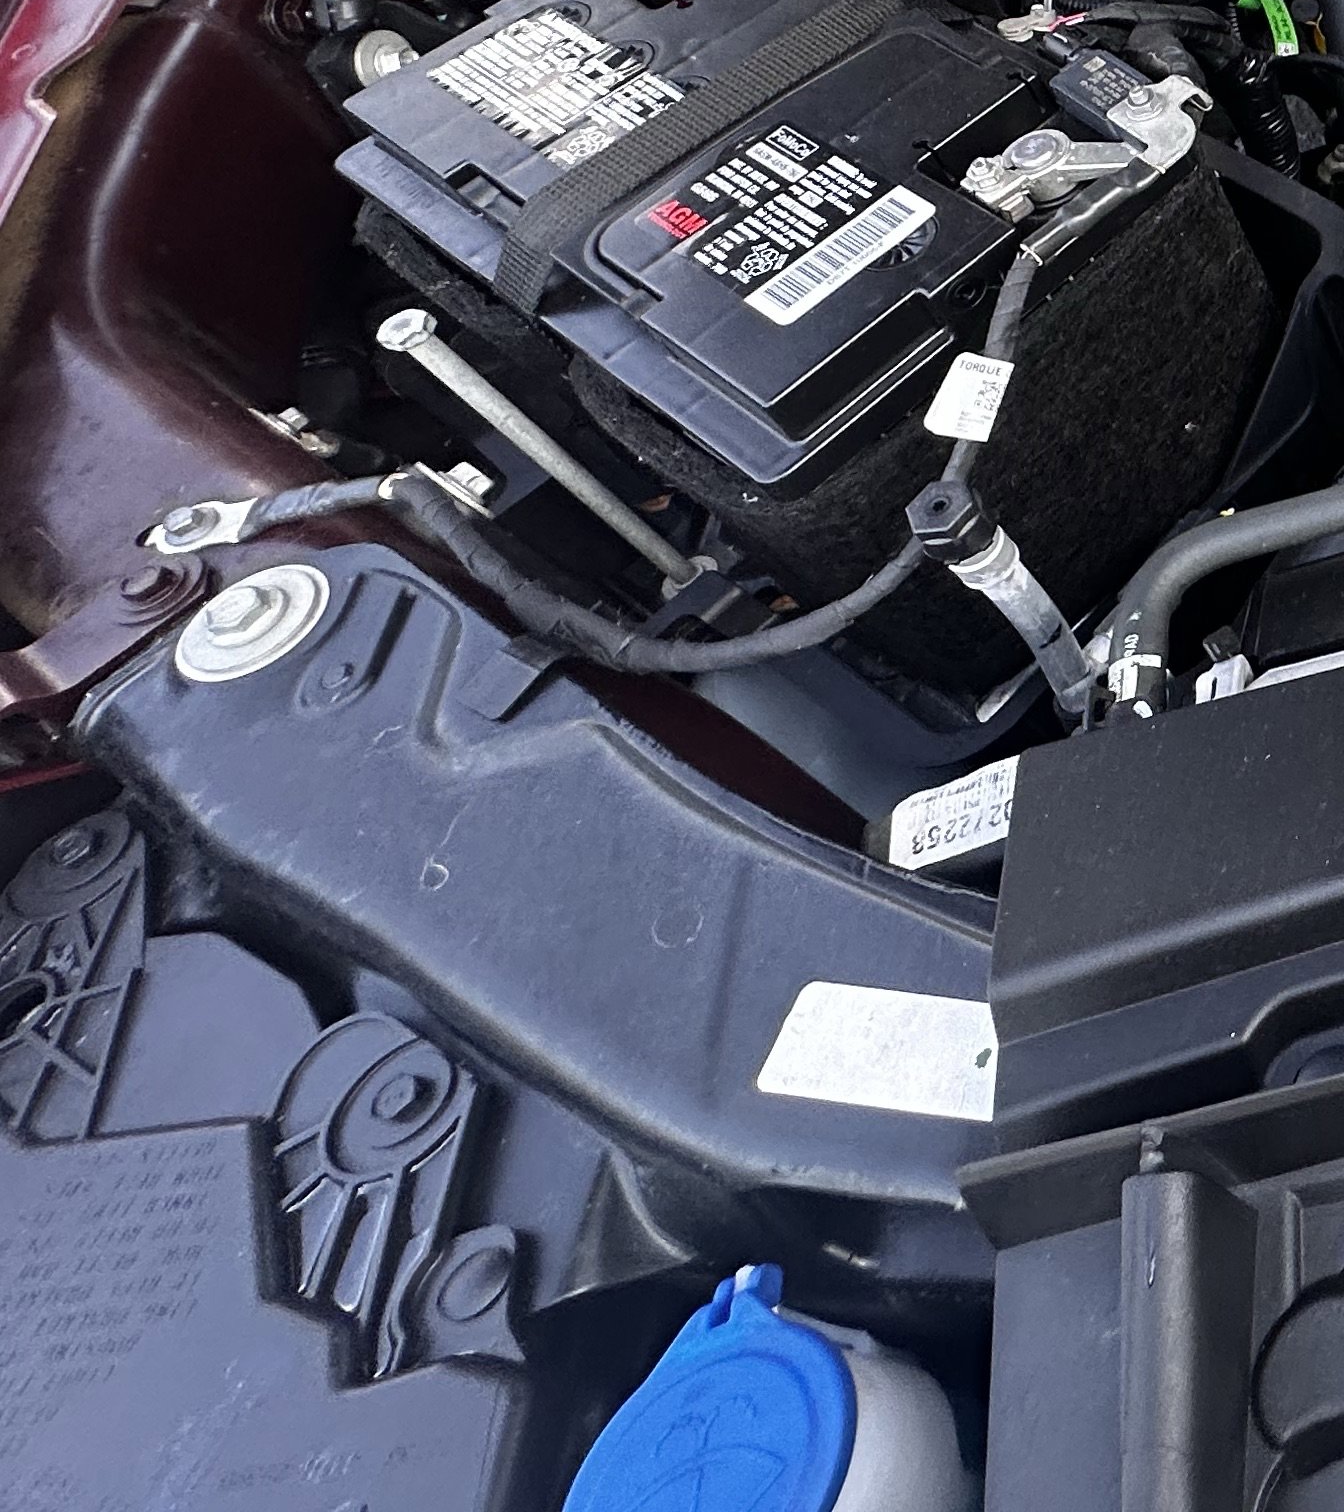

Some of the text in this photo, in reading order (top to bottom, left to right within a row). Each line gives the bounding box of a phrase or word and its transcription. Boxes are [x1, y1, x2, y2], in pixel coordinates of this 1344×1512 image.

[769, 128, 812, 158] FoMoCo
[655, 200, 708, 235] AGM
[959, 359, 1004, 377] TORQUE
